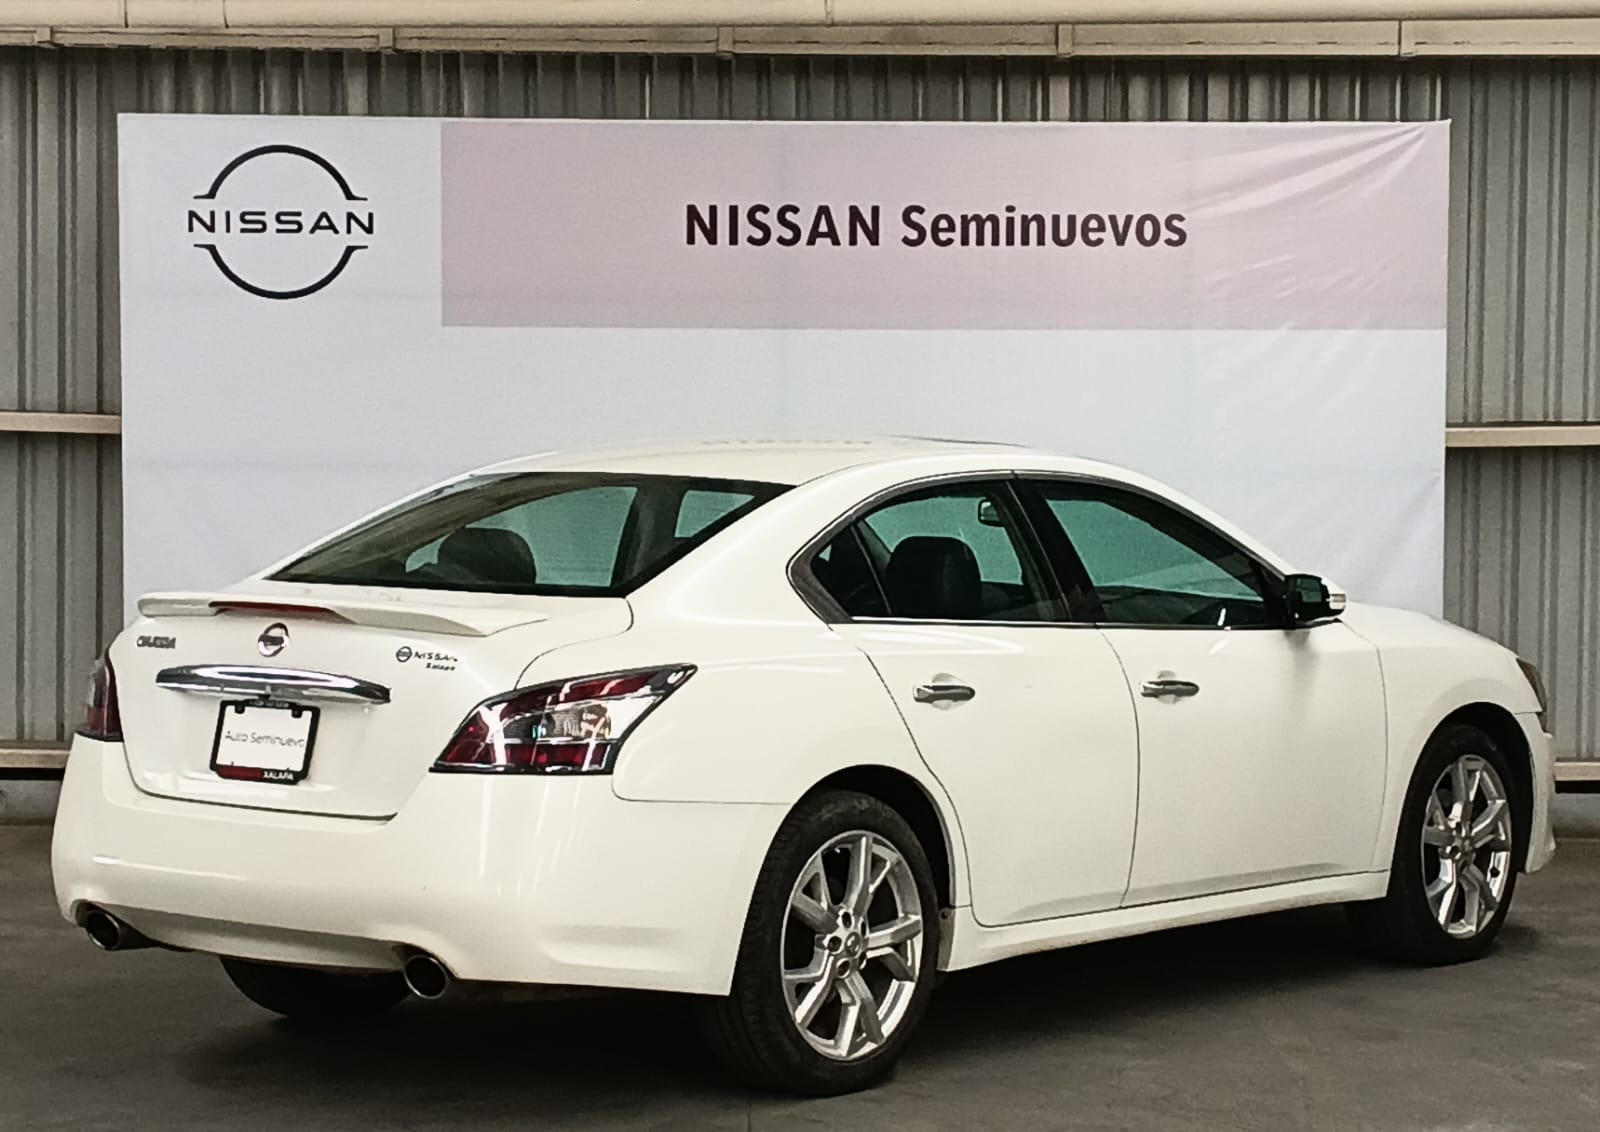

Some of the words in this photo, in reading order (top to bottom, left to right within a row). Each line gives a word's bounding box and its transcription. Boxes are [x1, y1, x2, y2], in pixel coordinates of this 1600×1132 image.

[187, 209, 375, 235] NISSAN
[686, 204, 881, 247] NISSAN
[901, 204, 1188, 248] Seminuevos
